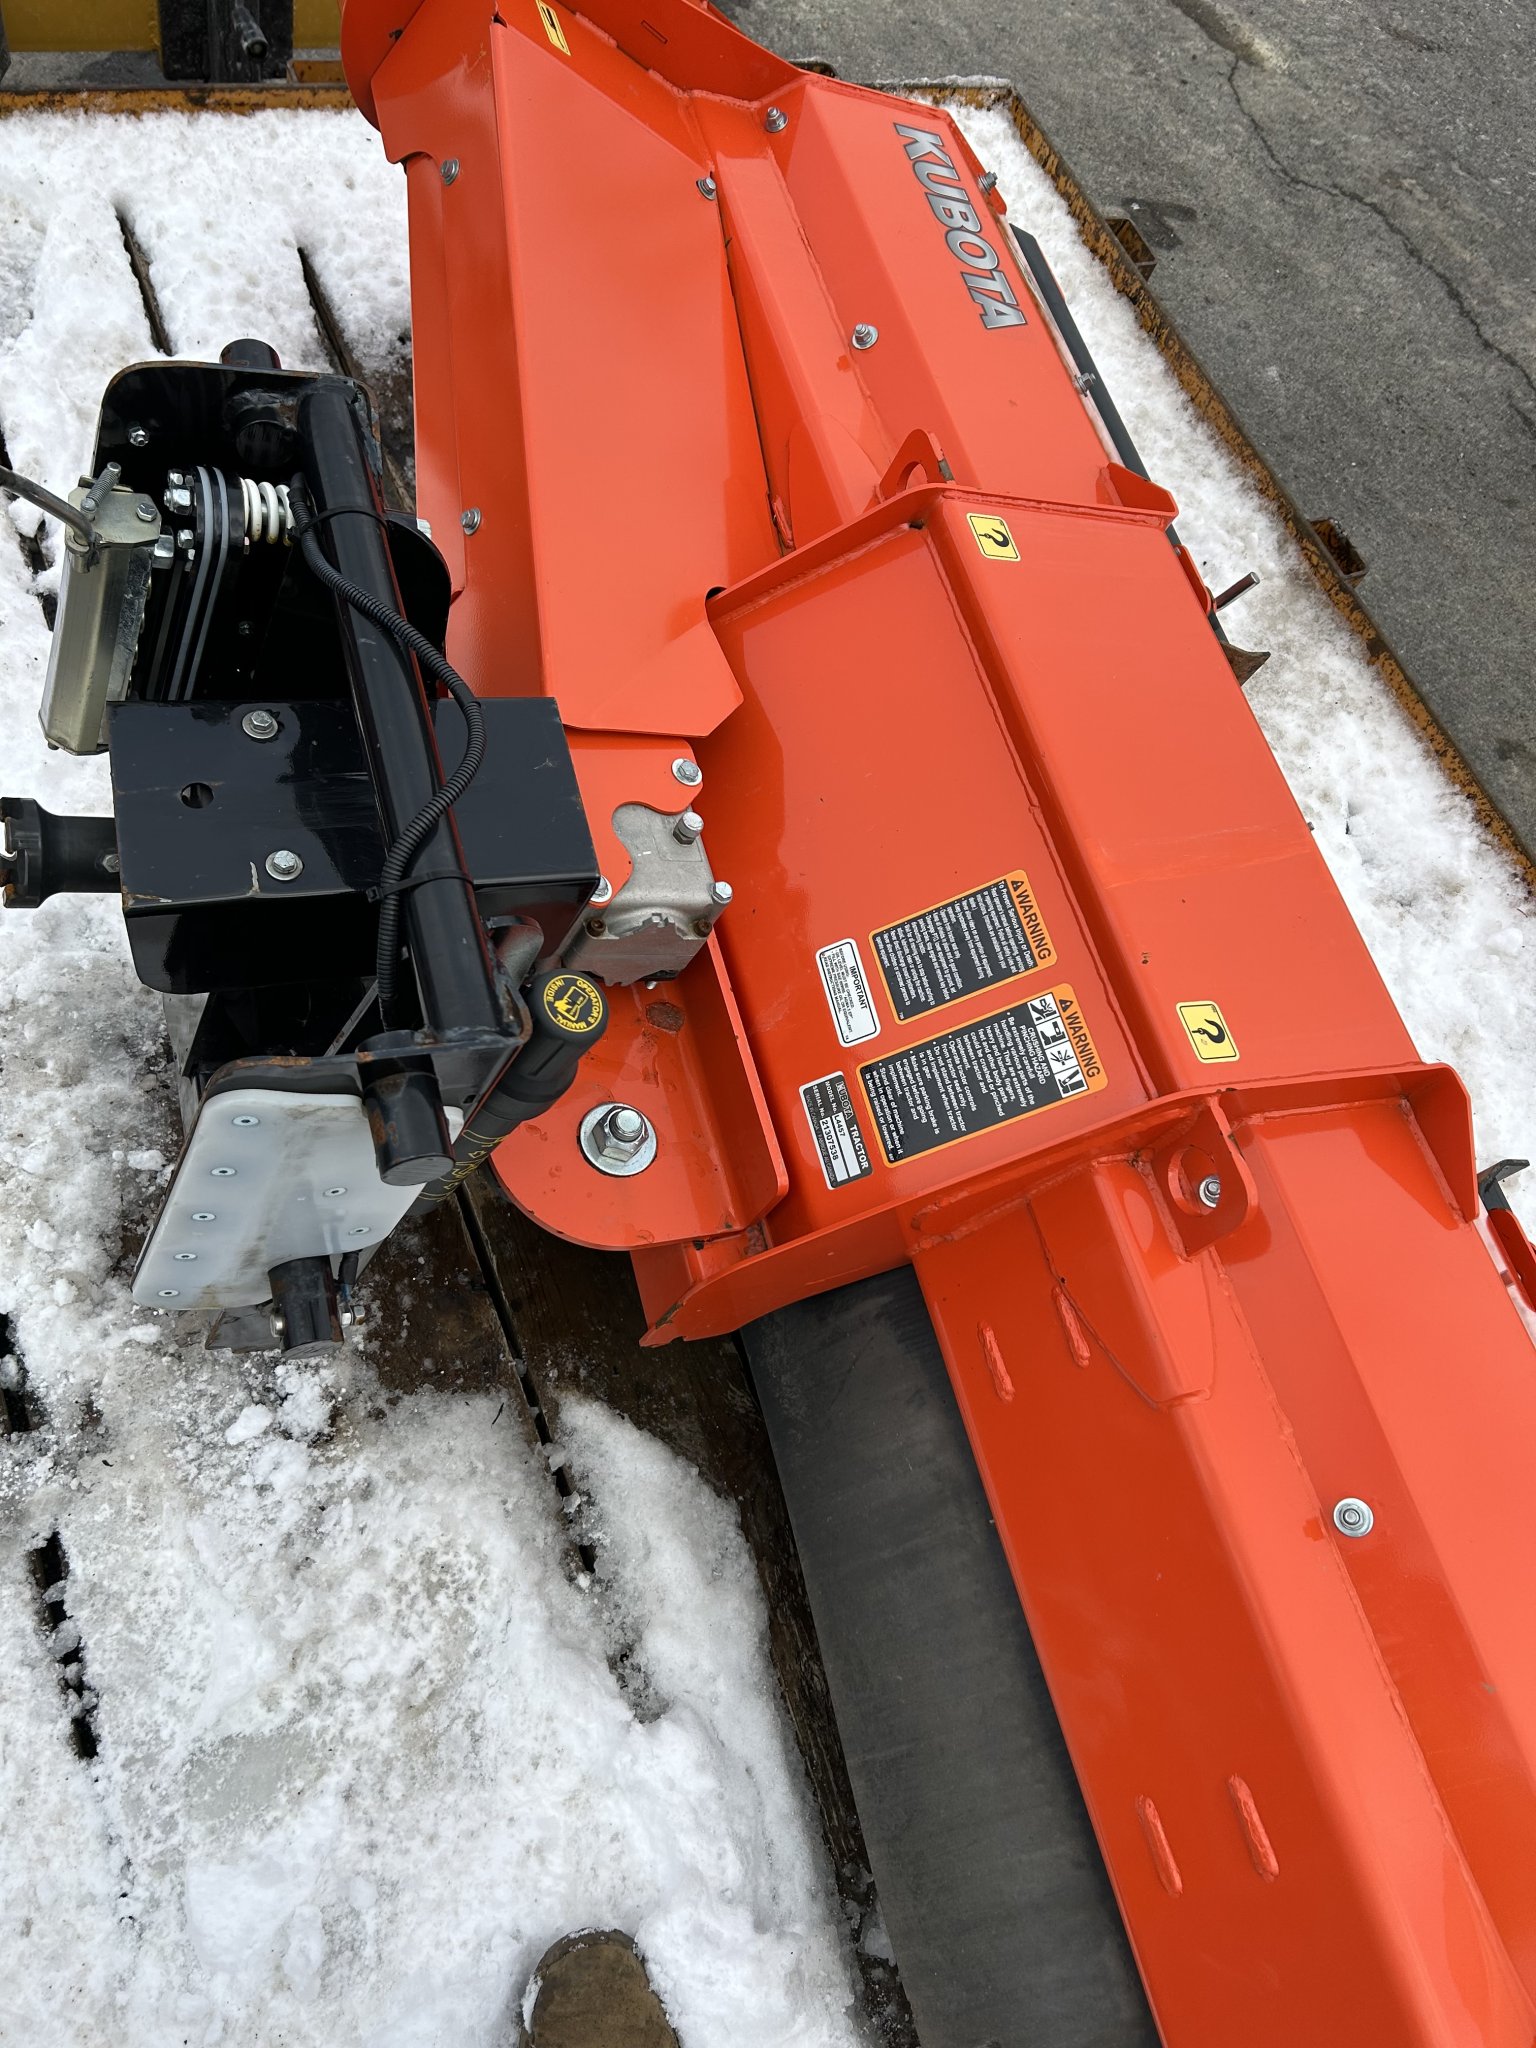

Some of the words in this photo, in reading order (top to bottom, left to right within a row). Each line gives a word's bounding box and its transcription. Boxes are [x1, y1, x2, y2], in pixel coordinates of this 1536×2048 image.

[893, 122, 1028, 330] KUBOTA
[997, 880, 1005, 889] To
[1000, 887, 1012, 908] Prevent
[1007, 907, 1020, 928] Serious
[1015, 889, 1052, 961] WARNING
[1013, 927, 1025, 945] Injury
[1020, 943, 1027, 951] or
[546, 979, 565, 1002] INSIDE
[848, 965, 867, 1010] IMPORTANT
[576, 980, 600, 1023] OPERATOR'S
[557, 1013, 587, 1029] MANUAL
[1007, 1016, 1016, 1025] Be
[969, 1030, 981, 1049] could
[977, 1027, 986, 1041] feet
[983, 1025, 996, 1044] heavy
[992, 1022, 1007, 1050] machine.
[998, 1019, 1014, 1046] handling
[1009, 1025, 1026, 1056] extremely
[933, 1045, 941, 1055] Do
[940, 1042, 950, 1058] from
[976, 1048, 984, 1058] be
[981, 1040, 991, 1053] and
[991, 1043, 1000, 1056] and
[1027, 1026, 1044, 1061] CRUSHING
[1039, 1061, 1050, 1077] AND
[1064, 1011, 1101, 1078] WARNING
[909, 1054, 919, 1072] Make
[920, 1057, 927, 1065] in
[925, 1048, 934, 1061] and
[936, 1055, 945, 1066] not
[962, 1034, 976, 1060] between
[971, 1059, 983, 1081] tractor
[978, 1080, 988, 1094] and
[986, 1052, 997, 1070] other
[1001, 1049, 1013, 1066] They
[1009, 1046, 1023, 1069] various
[1018, 1024, 1035, 1056] PINCHING
[1030, 1056, 1046, 1085] HAZARD
[878, 1067, 890, 1085] Stand
[921, 1065, 932, 1082] gear.
[928, 1060, 945, 1093] implement
[940, 1065, 951, 1084] stand
[945, 1057, 958, 1079] tractor
[946, 1039, 961, 1065] Operate
[956, 1064, 968, 1085] tractor
[963, 1084, 977, 1111] controls
[979, 1057, 993, 1083] crushed
[995, 1056, 1008, 1078] hands,
[1008, 1065, 1016, 1077] are
[872, 1069, 882, 1087] when
[914, 1071, 923, 1086] sure
[953, 1078, 962, 1093] seat
[988, 1083, 995, 1091] or
[990, 1069, 1003, 1087] body
[1017, 1069, 1029, 1086] parts
[811, 1084, 823, 1107] SERIAL
[865, 1079, 877, 1097] being
[877, 1086, 884, 1094] in
[884, 1085, 894, 1100] clear
[894, 1060, 908, 1086] between
[903, 1086, 915, 1107] tractor
[910, 1106, 919, 1120] and
[900, 1057, 915, 1085] engaged
[910, 1084, 922, 1104] before
[916, 1104, 929, 1123] going
[918, 1085, 932, 1110] parking
[946, 1084, 960, 1110] between
[996, 1086, 1009, 1104] parts
[1002, 1077, 1017, 1102] fingers,
[1010, 1076, 1028, 1108] extremely
[1024, 1085, 1032, 1094] of
[872, 1096, 883, 1116] raised
[878, 1093, 894, 1124] operation
[890, 1100, 897, 1108] of
[940, 1092, 951, 1110] when
[956, 1092, 968, 1109] only.
[989, 1090, 1005, 1117] pinched
[1027, 1093, 1036, 1105] the
[818, 1107, 826, 1118] No.
[824, 1080, 835, 1102] MODEL
[833, 1114, 845, 1138] L4457
[927, 1109, 939, 1128] brake
[835, 1080, 854, 1120] KUBOTA
[848, 1124, 868, 1169] TRACTOR
[878, 1116, 885, 1124] or
[888, 1123, 895, 1131] or
[892, 1107, 906, 1135] machine
[946, 1109, 959, 1131] tractor
[955, 1110, 967, 1132] tractor
[820, 1119, 839, 1161] 21307538
[881, 1123, 894, 1150] lowered.
[891, 1130, 902, 1148] when
